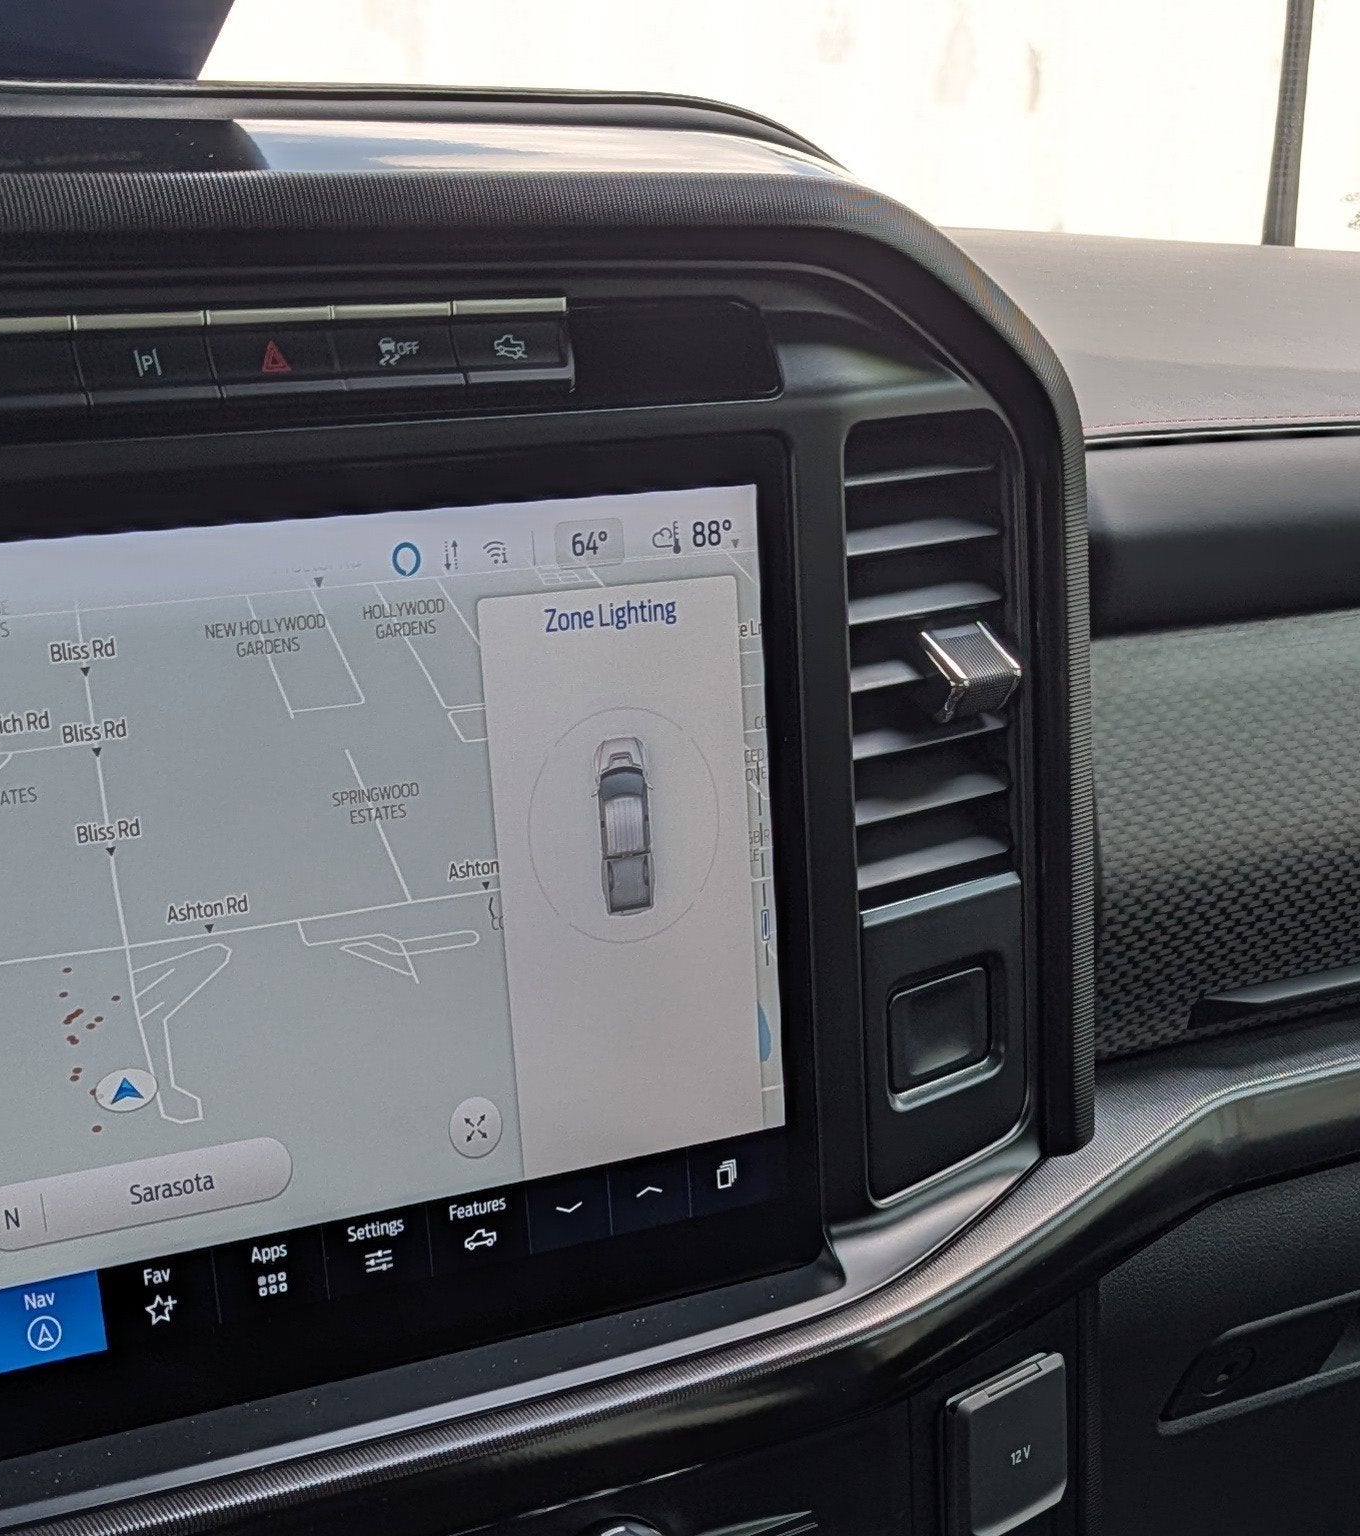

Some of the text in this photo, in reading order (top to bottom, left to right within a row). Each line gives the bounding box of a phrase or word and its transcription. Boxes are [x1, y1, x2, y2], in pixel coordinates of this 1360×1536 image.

[363, 599, 446, 620] HOLLYWOOD
[545, 598, 677, 633] Zone Lighting
[204, 613, 326, 640] NEW HOLLYWOOD
[375, 620, 437, 639] GARDENS
[50, 638, 115, 663] Bliss Rd
[236, 638, 300, 657] GARDENS
[26, 710, 50, 732] Rd
[62, 719, 127, 744] Bliss Rd
[332, 782, 420, 807] SPRINGWOOD
[350, 803, 407, 825] ESTATES
[76, 819, 141, 845] Bliss Rd
[448, 861, 499, 880] Ashton
[167, 894, 248, 923] Ashton Rd
[129, 1170, 215, 1205] Sarasota
[4, 1208, 21, 1230] N
[448, 1195, 506, 1223] Features
[347, 1214, 405, 1246] Settings
[250, 1242, 288, 1268] Apps
[142, 1266, 171, 1287] Fav
[23, 1289, 56, 1312] Nav
[1010, 1445, 1032, 1466] 12 V
